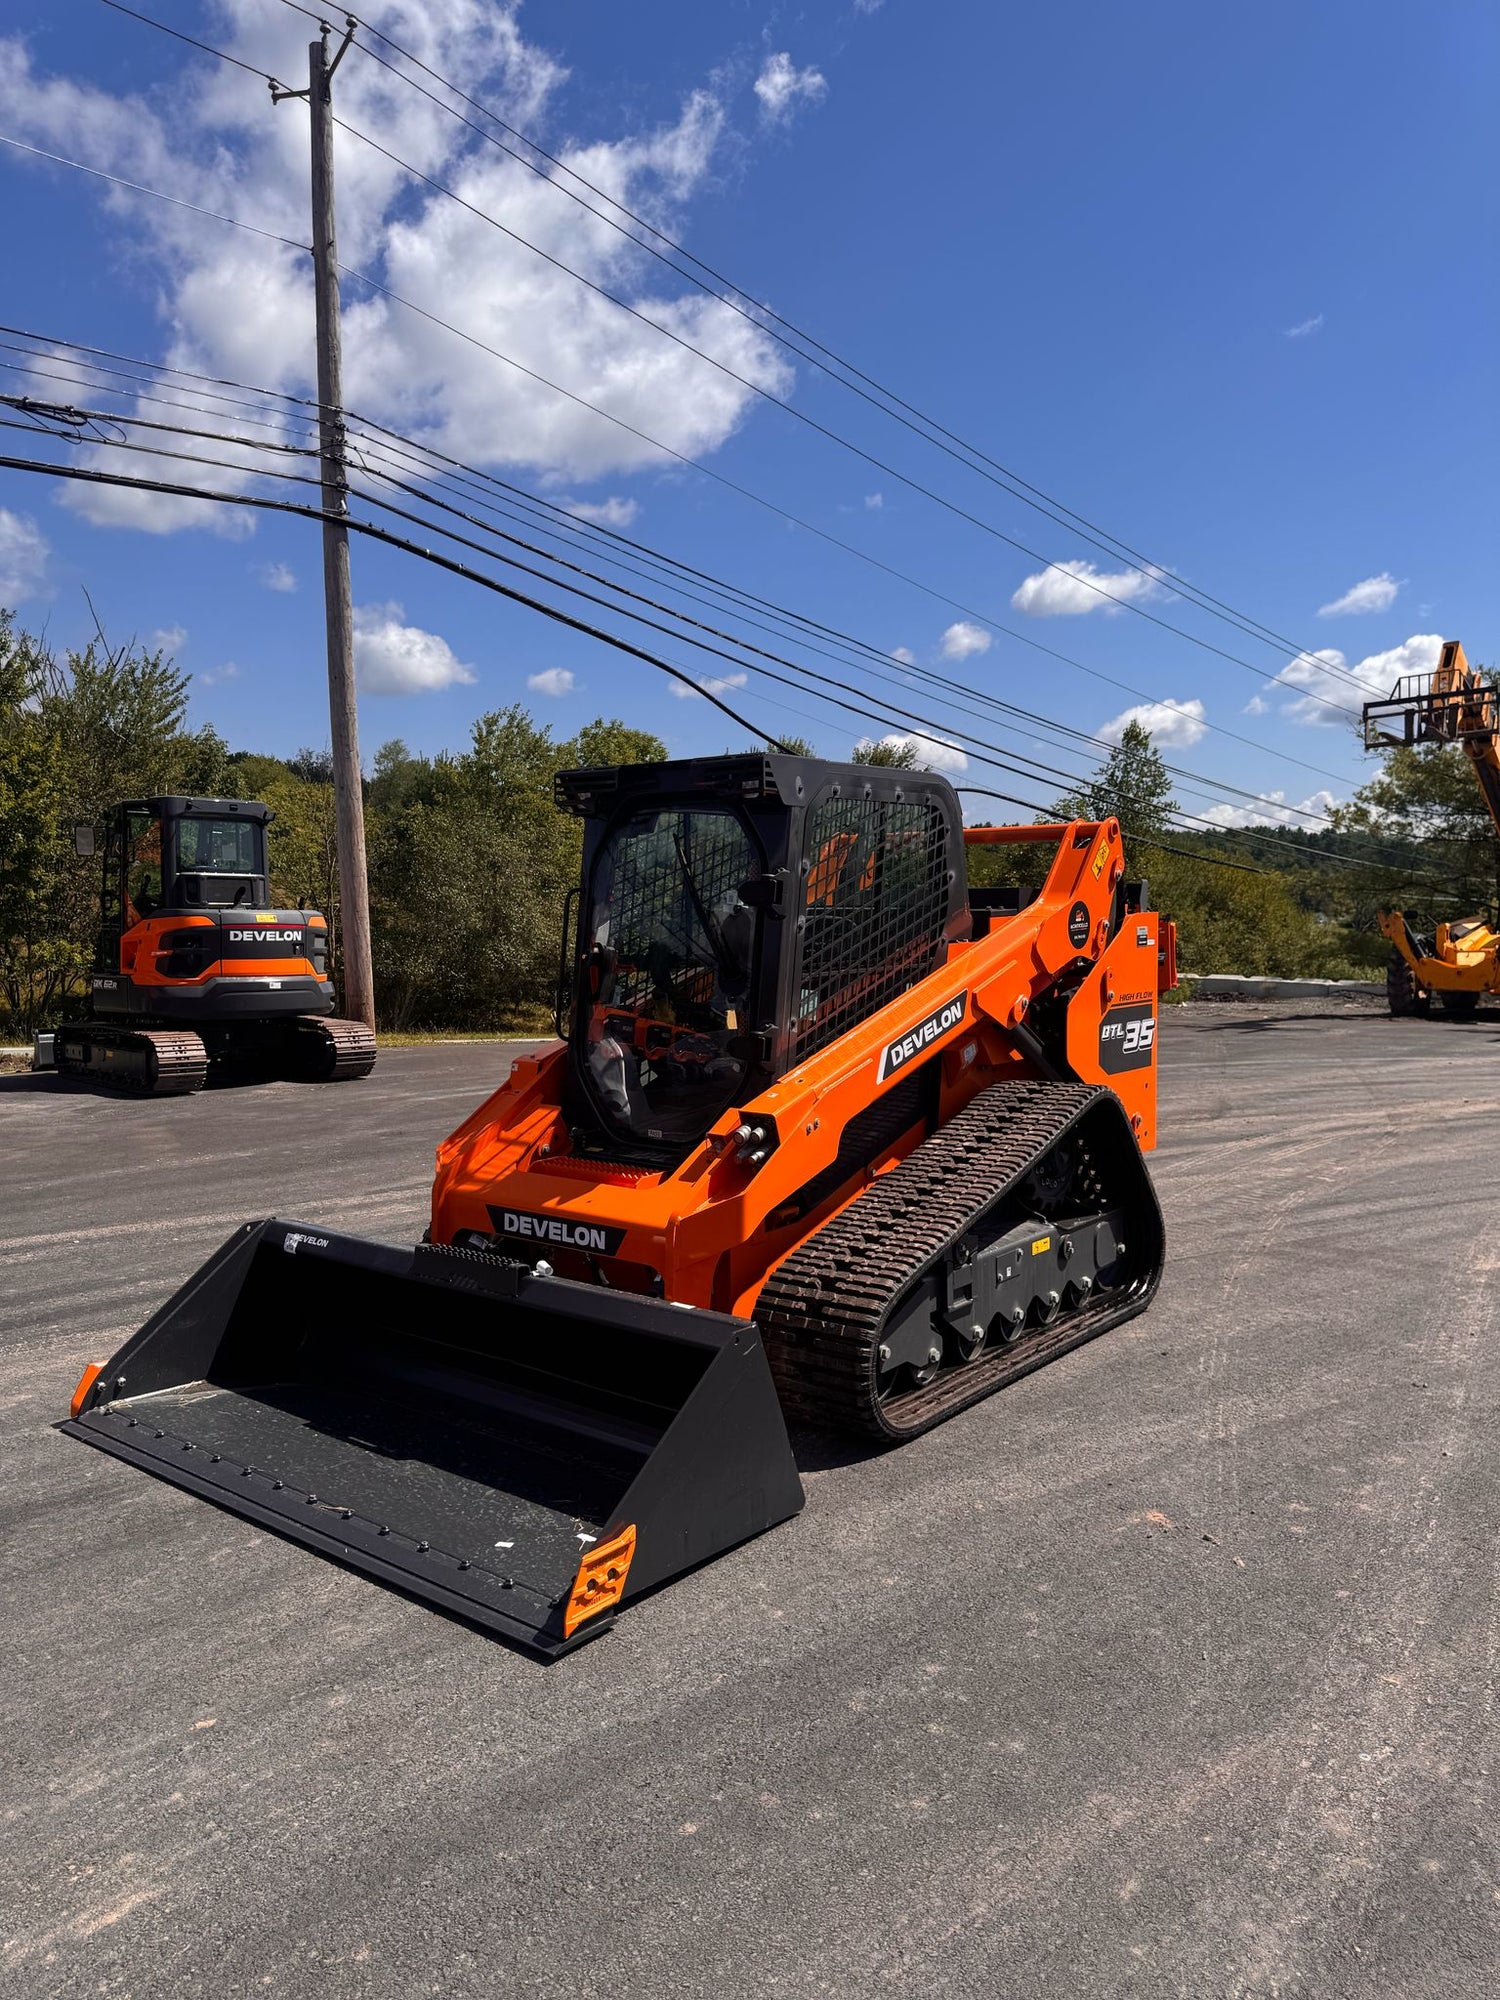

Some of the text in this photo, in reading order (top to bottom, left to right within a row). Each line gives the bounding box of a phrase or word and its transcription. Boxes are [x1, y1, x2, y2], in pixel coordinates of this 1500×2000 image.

[229, 930, 302, 942] DEVELON
[1119, 991, 1154, 1002] HIGH FLOW
[890, 1001, 962, 1067] DEVELON
[1101, 1018, 1156, 1054] DTL 35
[503, 1212, 606, 1250] DEVELON
